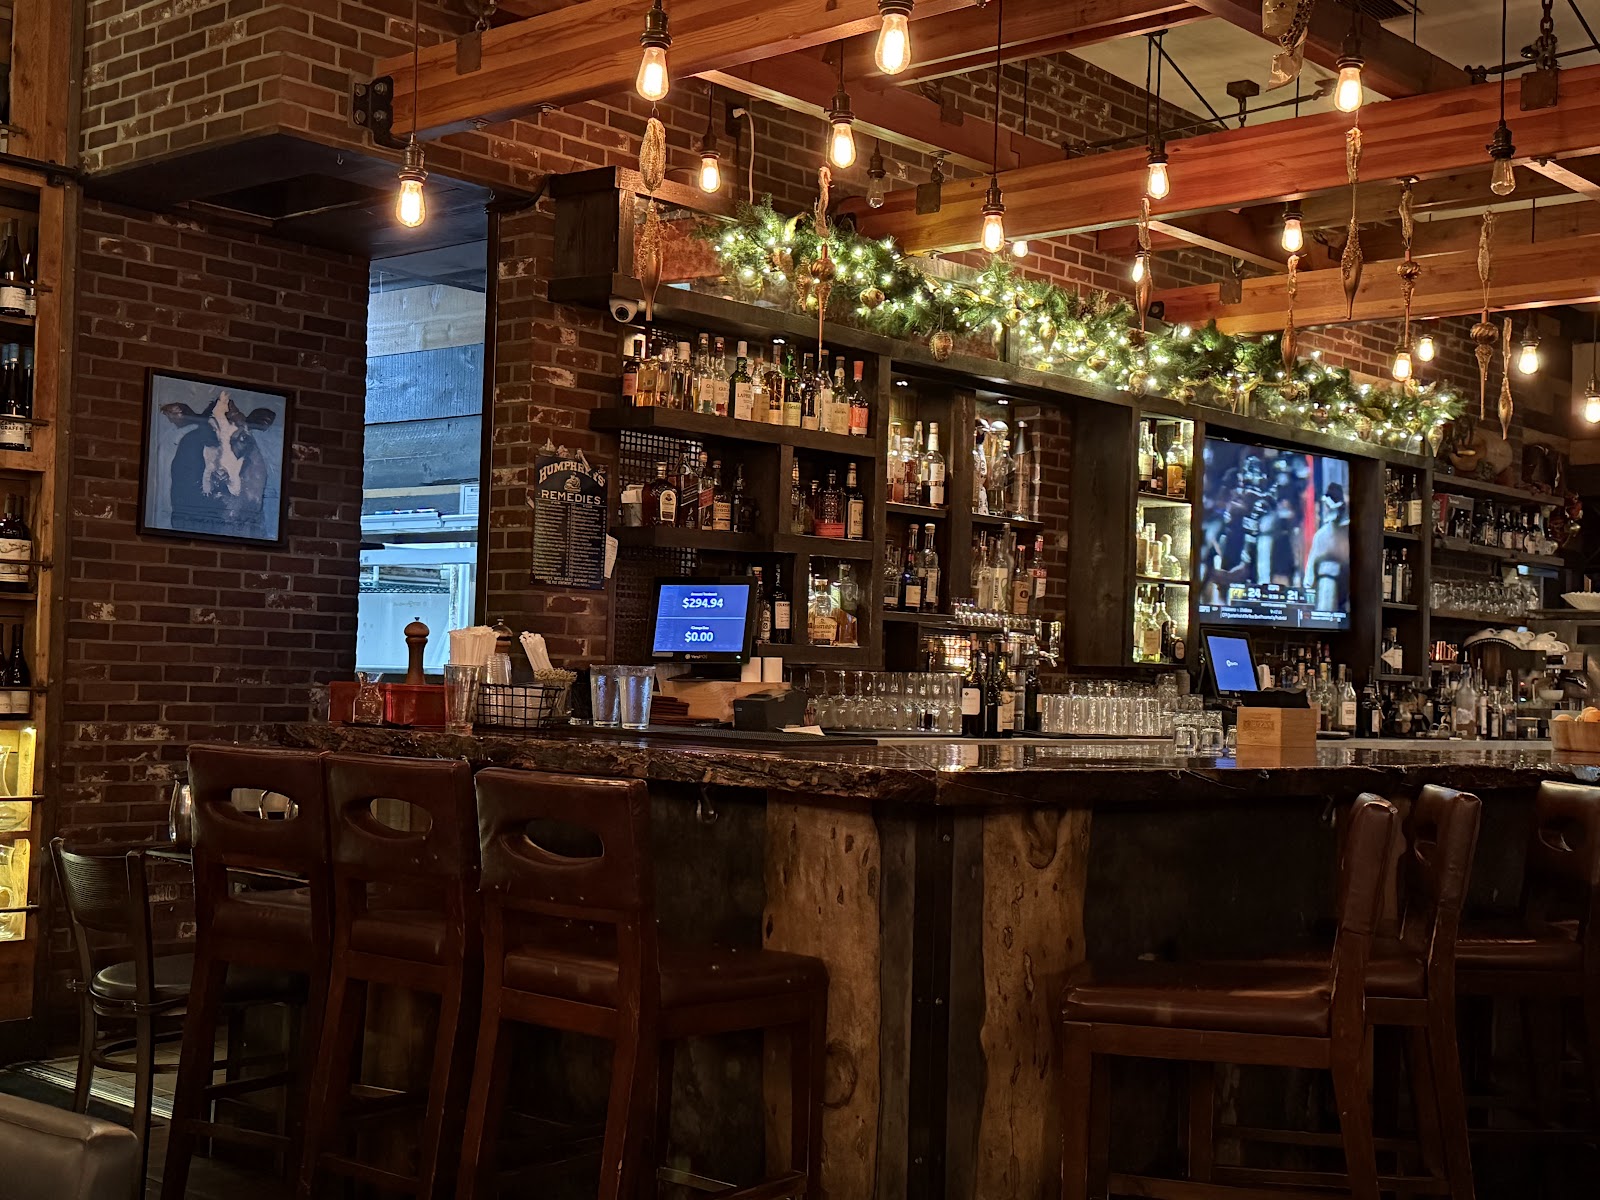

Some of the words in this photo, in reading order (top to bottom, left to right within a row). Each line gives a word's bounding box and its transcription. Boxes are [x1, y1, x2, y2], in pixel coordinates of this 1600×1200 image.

[541, 490, 601, 505] REMEDIES
[1248, 588, 1261, 598] 24
[1287, 590, 1298, 600] 21
[682, 598, 723, 608] $294.94
[685, 631, 713, 642] $0.00
